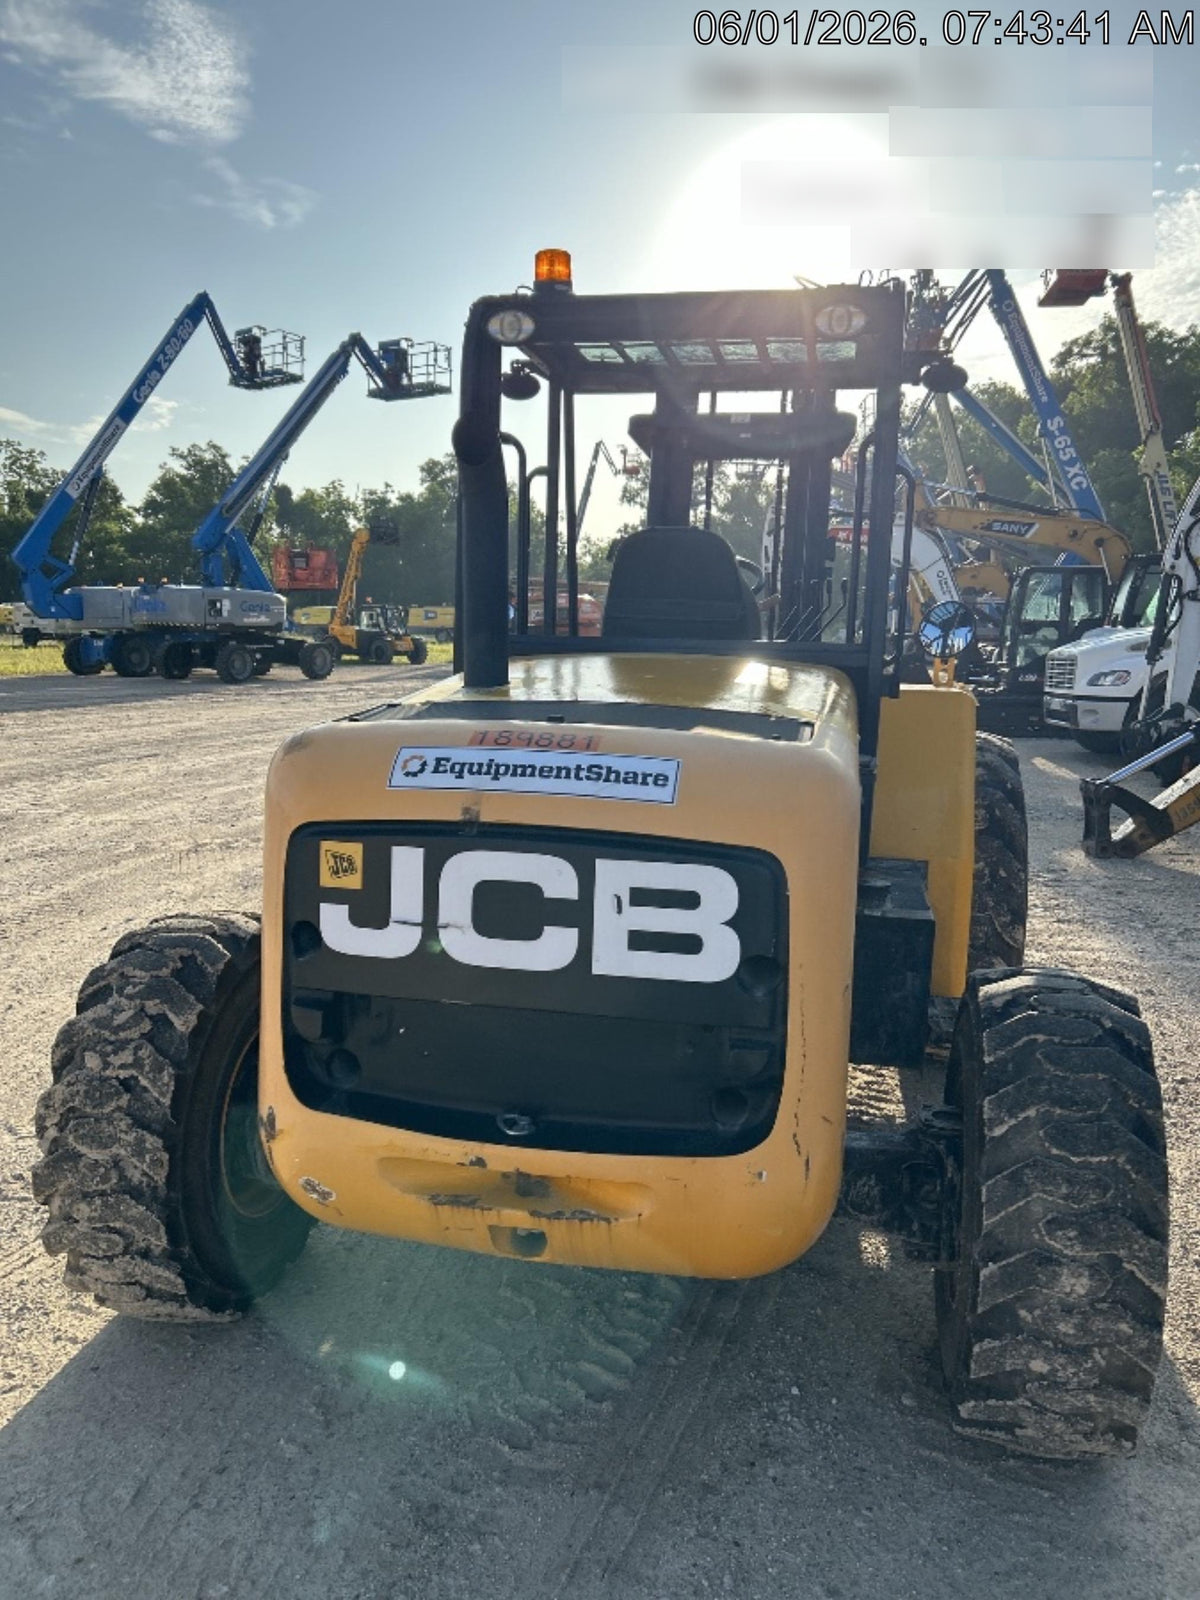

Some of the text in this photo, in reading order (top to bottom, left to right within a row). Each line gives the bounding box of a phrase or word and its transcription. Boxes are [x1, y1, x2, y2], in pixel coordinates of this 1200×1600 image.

[1047, 415, 1088, 490] S-65 XC
[992, 522, 1029, 535] SANY
[478, 730, 595, 750] 189881
[431, 756, 670, 788] EquipmentShare
[330, 851, 358, 879] JCB
[319, 845, 741, 984] JCB
